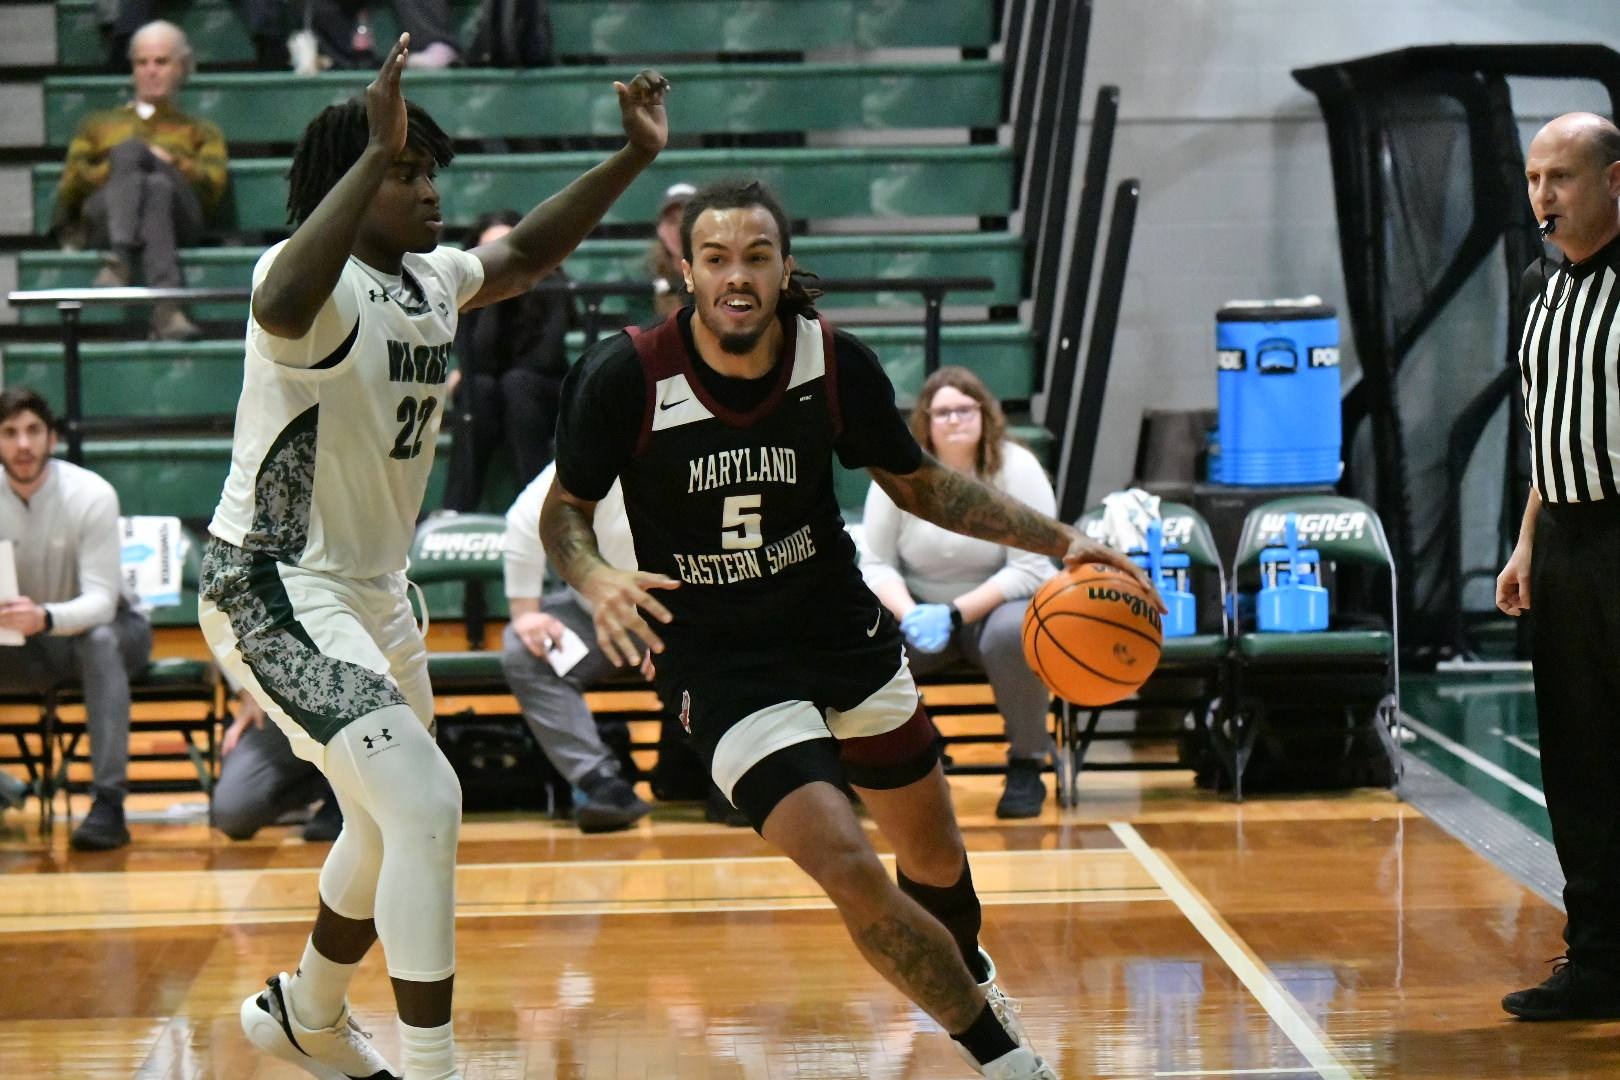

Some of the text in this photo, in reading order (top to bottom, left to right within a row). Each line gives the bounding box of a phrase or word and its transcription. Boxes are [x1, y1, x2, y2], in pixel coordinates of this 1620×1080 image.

[387, 340, 452, 385] WAGNE
[389, 396, 437, 460] 22
[687, 446, 797, 494] MARYLAND
[721, 494, 763, 550] 5
[673, 524, 817, 585] EASTERN SHORE
